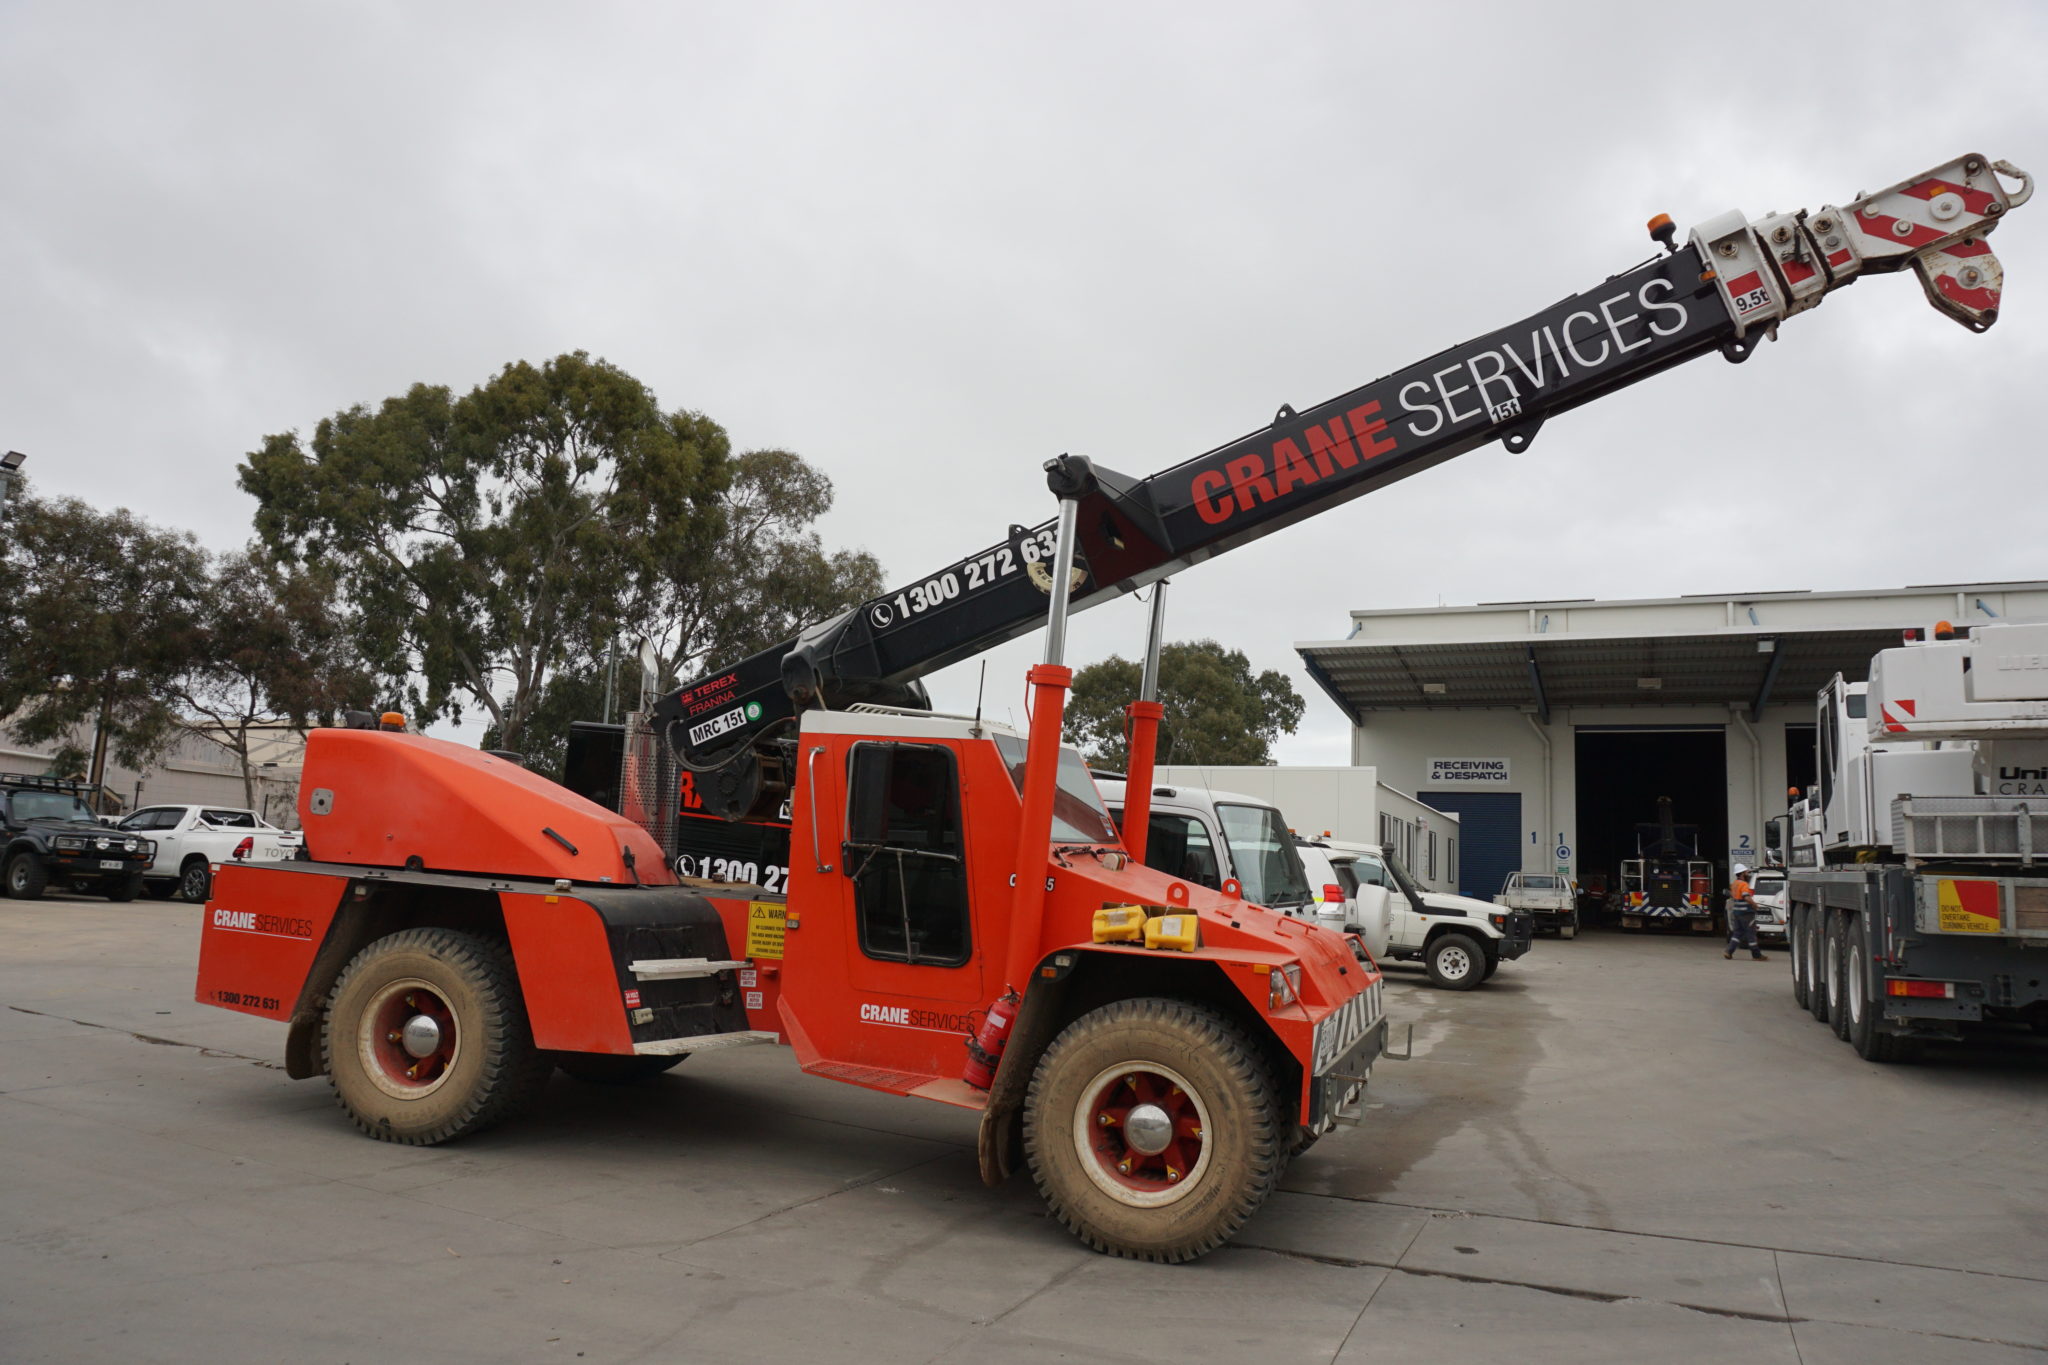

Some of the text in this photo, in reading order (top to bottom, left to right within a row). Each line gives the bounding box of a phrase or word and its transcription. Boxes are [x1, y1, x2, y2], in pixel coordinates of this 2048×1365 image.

[1736, 288, 1769, 311] 9.5t
[1191, 278, 1688, 525] CRANE SERVICES
[1491, 401, 1520, 421] 15t
[894, 529, 1058, 619] 1300 272 63
[694, 673, 737, 697] TEREX
[689, 690, 736, 716] FRANNA
[692, 720, 721, 743] MRC
[723, 710, 744, 728] 15t
[1431, 771, 1507, 780] & DESPATCH
[1433, 761, 1504, 770] RECEIVING
[1531, 831, 1537, 845] 1
[1558, 832, 1564, 845] 1
[1739, 835, 1750, 848] 2
[699, 856, 758, 886] 1300
[213, 908, 313, 937] CRANE SERVICES
[1942, 913, 1970, 921] OVERTAKE
[1967, 922, 1990, 930] VEHICLE
[218, 991, 279, 1010] 1300 272 631
[860, 1003, 975, 1033] CRANE SERVICES
